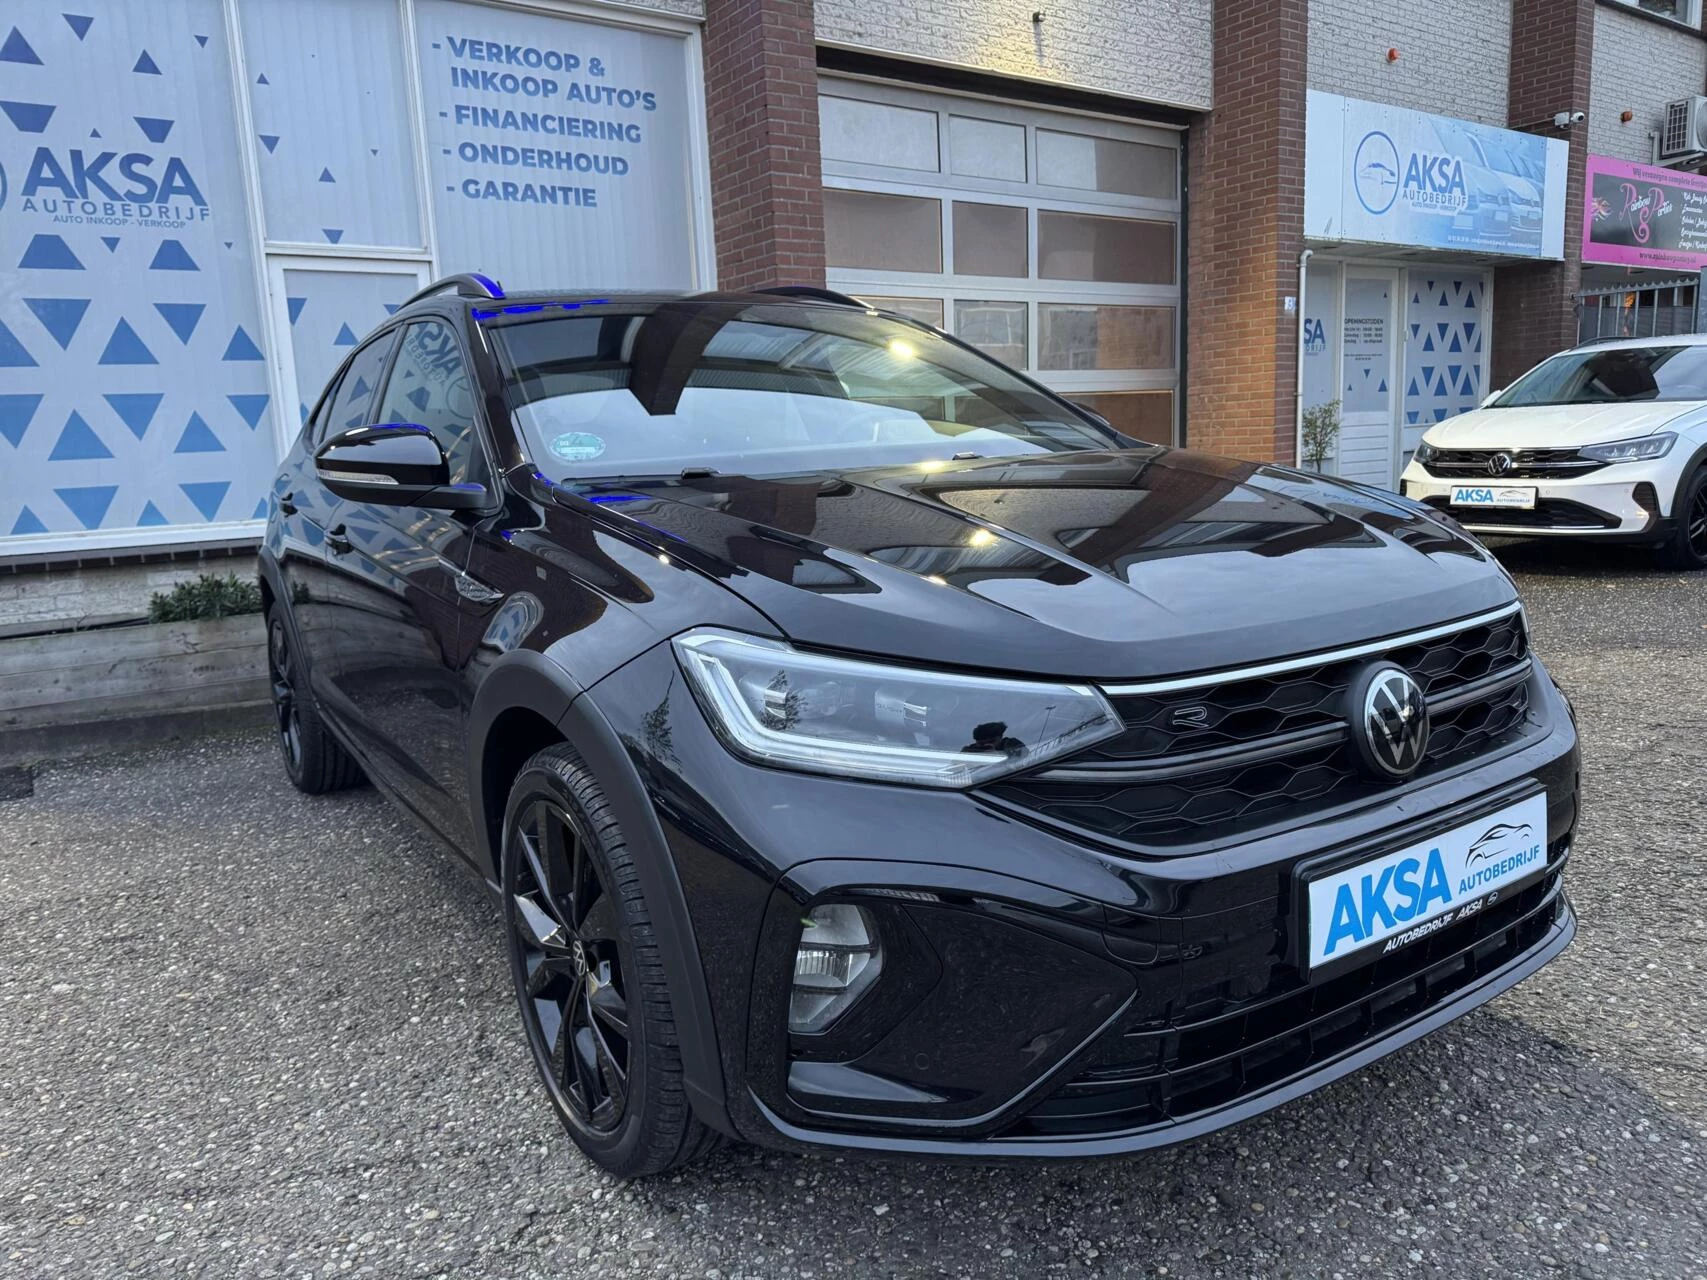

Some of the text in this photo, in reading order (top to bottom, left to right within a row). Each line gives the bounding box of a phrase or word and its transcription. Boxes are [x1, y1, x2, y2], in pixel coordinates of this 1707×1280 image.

[446, 36, 581, 73] VERKOOP
[588, 57, 605, 77] &
[450, 66, 657, 111] INKOOP AUTO'S
[454, 104, 641, 143] FINANCIERING
[21, 147, 208, 206] AKSA
[458, 141, 629, 176] ONDERHOUD
[1403, 152, 1467, 196] AKSA
[22, 198, 210, 221] AUTOBEDRIJF
[462, 178, 597, 207] GARANTIE
[1402, 190, 1467, 208] AUTOBEDRIJF
[53, 215, 83, 224] AUTO
[86, 217, 128, 227] INKOOP
[138, 219, 187, 229] VERKOOP
[1304, 318, 1326, 344] SA
[1454, 488, 1495, 503] AKSA
[1323, 844, 1540, 956] AKSA AUTOBEDRIJF
[1382, 898, 1483, 954] AUTOBEDRIJF AKSA
